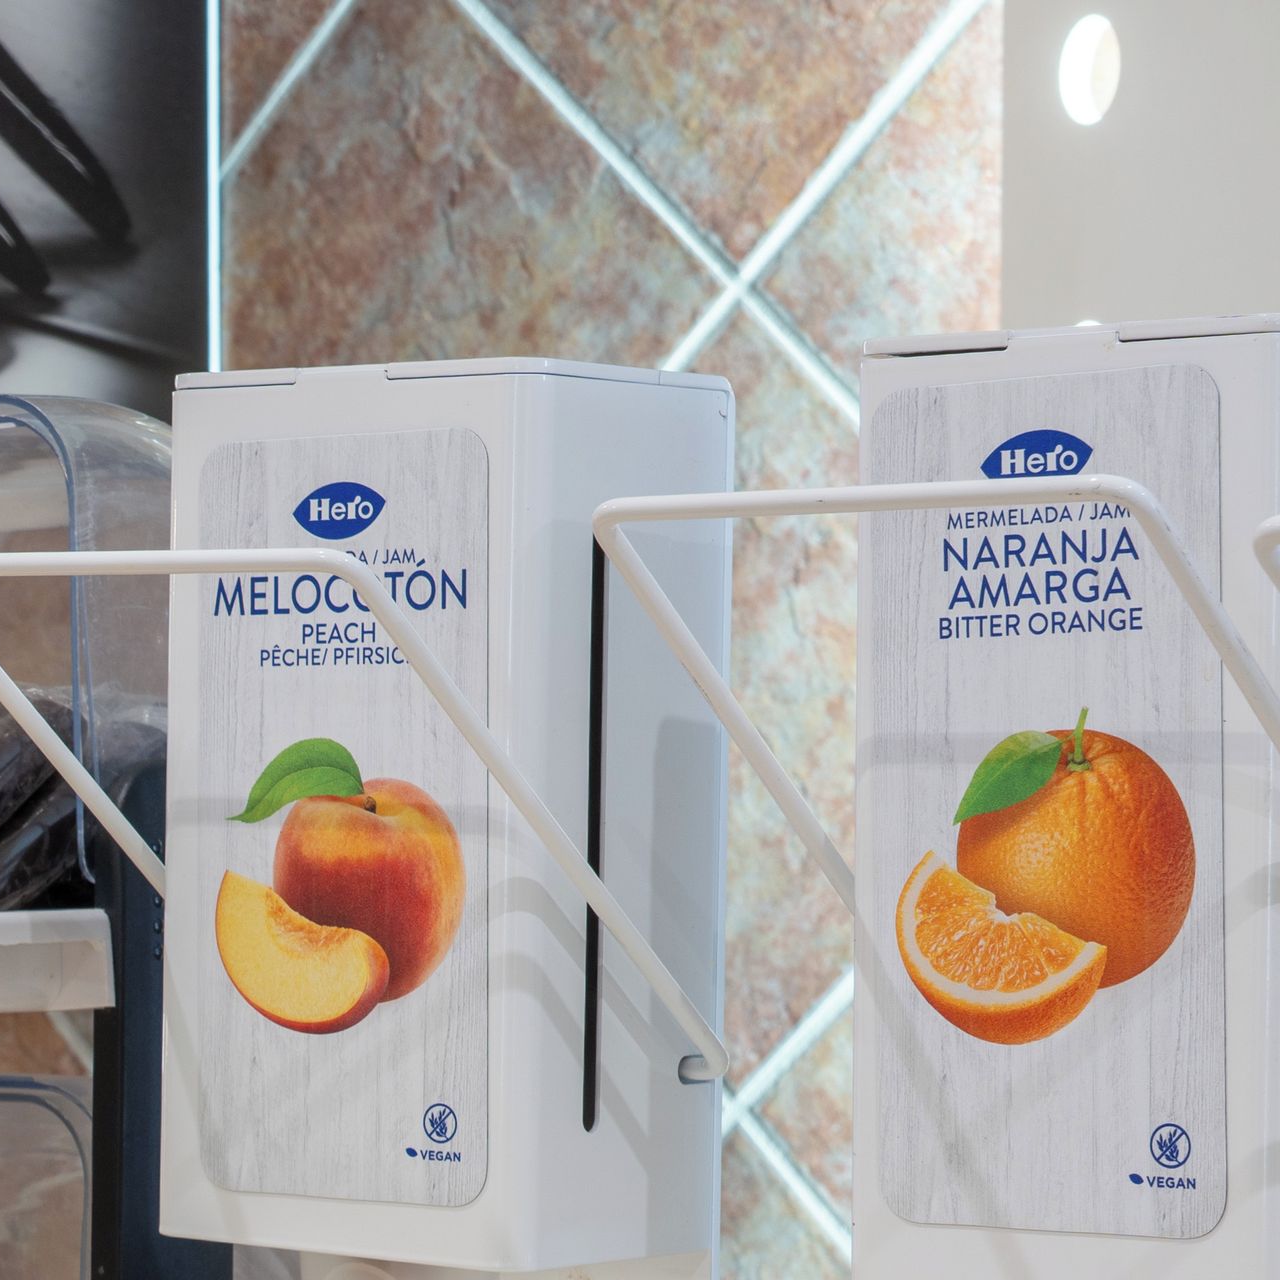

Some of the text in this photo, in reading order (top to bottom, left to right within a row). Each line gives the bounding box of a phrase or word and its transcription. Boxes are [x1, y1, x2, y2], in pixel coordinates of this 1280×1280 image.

[1000, 444, 1078, 475] Hero
[309, 496, 374, 521] Hero
[947, 506, 1072, 530] MERMELADA
[1090, 502, 1130, 520] JAM
[382, 548, 416, 565] JAM
[943, 526, 1139, 572] NARANJA
[948, 566, 1131, 610] AMARGA
[302, 622, 376, 645] PEACH
[939, 607, 1143, 639] BITTER ORANGE
[333, 646, 410, 666] PFIRSIC
[420, 1149, 461, 1162] VEGAN
[1146, 1175, 1196, 1189] VEGAN
